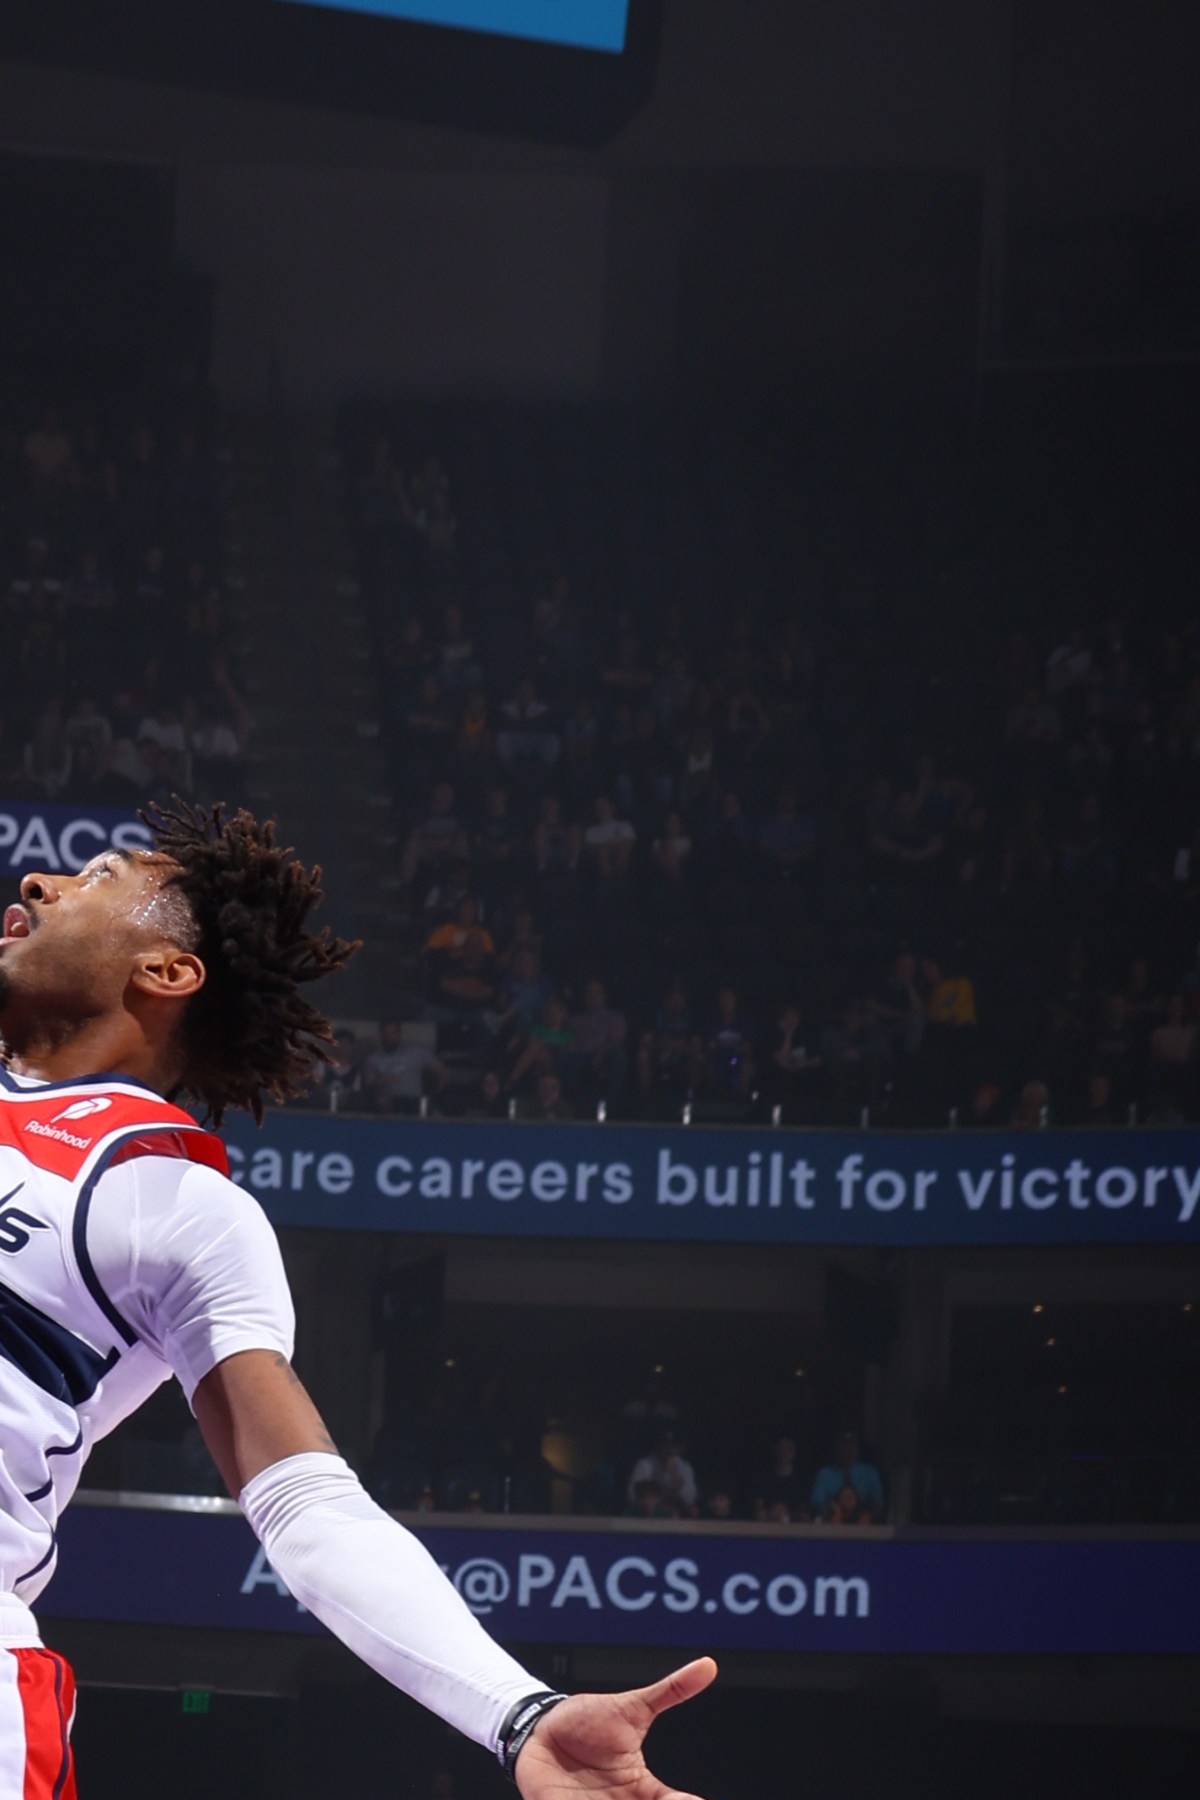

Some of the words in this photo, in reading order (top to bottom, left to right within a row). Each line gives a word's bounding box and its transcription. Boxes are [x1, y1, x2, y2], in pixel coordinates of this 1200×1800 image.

[24, 1118, 92, 1150] Robinhood
[376, 1155, 633, 1203] careers
[656, 1148, 816, 1209] built
[835, 1154, 938, 1211] for
[958, 1154, 1200, 1222] victory
[240, 1554, 870, 1618] A@PACS.com
